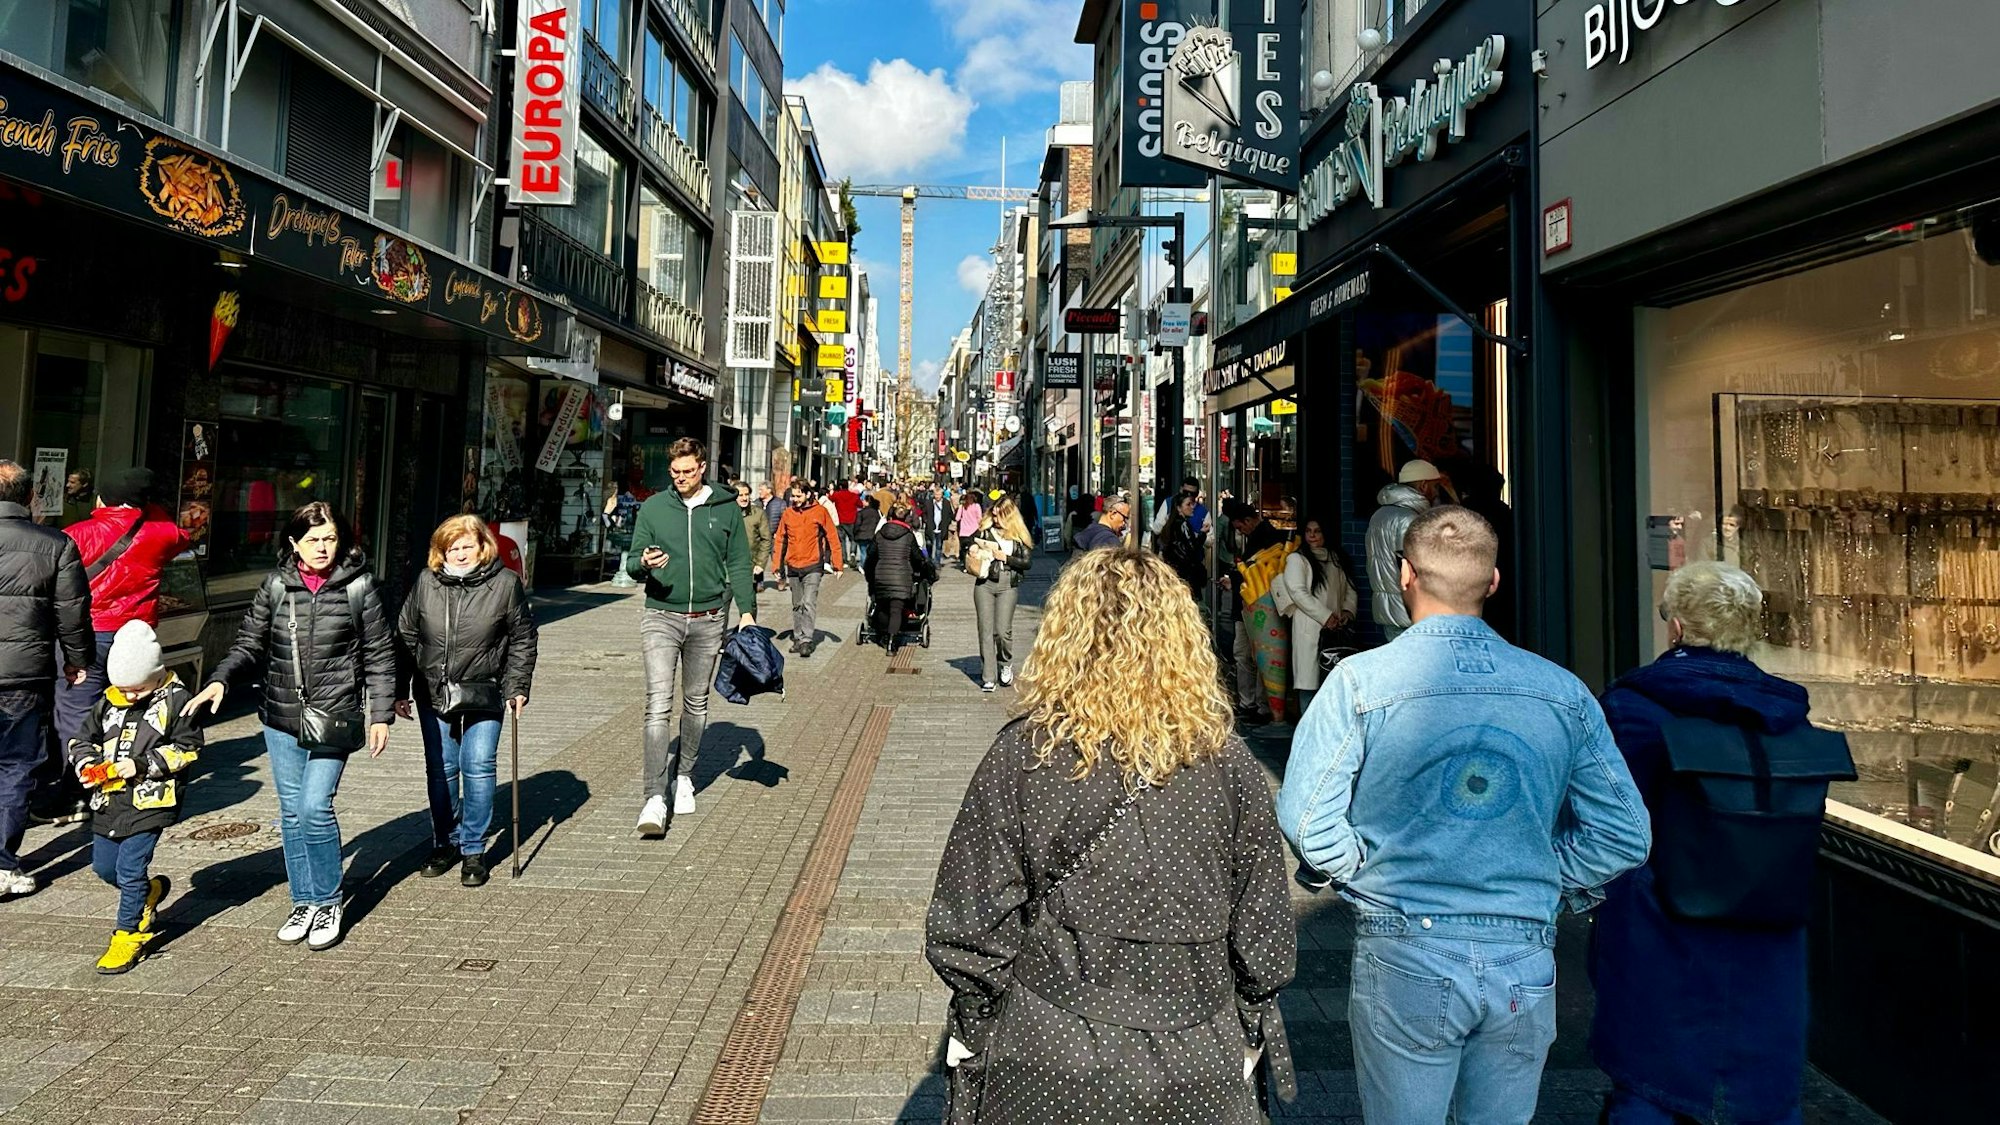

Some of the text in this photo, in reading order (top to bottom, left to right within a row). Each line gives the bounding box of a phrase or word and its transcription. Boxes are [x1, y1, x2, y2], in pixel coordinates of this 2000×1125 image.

[522, 8, 568, 194] EUROPA
[61, 116, 121, 175] Fries
[1174, 120, 1290, 174] Belgique
[339, 236, 369, 275] Teller
[1048, 357, 1077, 366] LUSH
[1048, 366, 1077, 374] FRESH
[541, 440, 558, 466] Stark
[555, 388, 581, 437] reduziert
